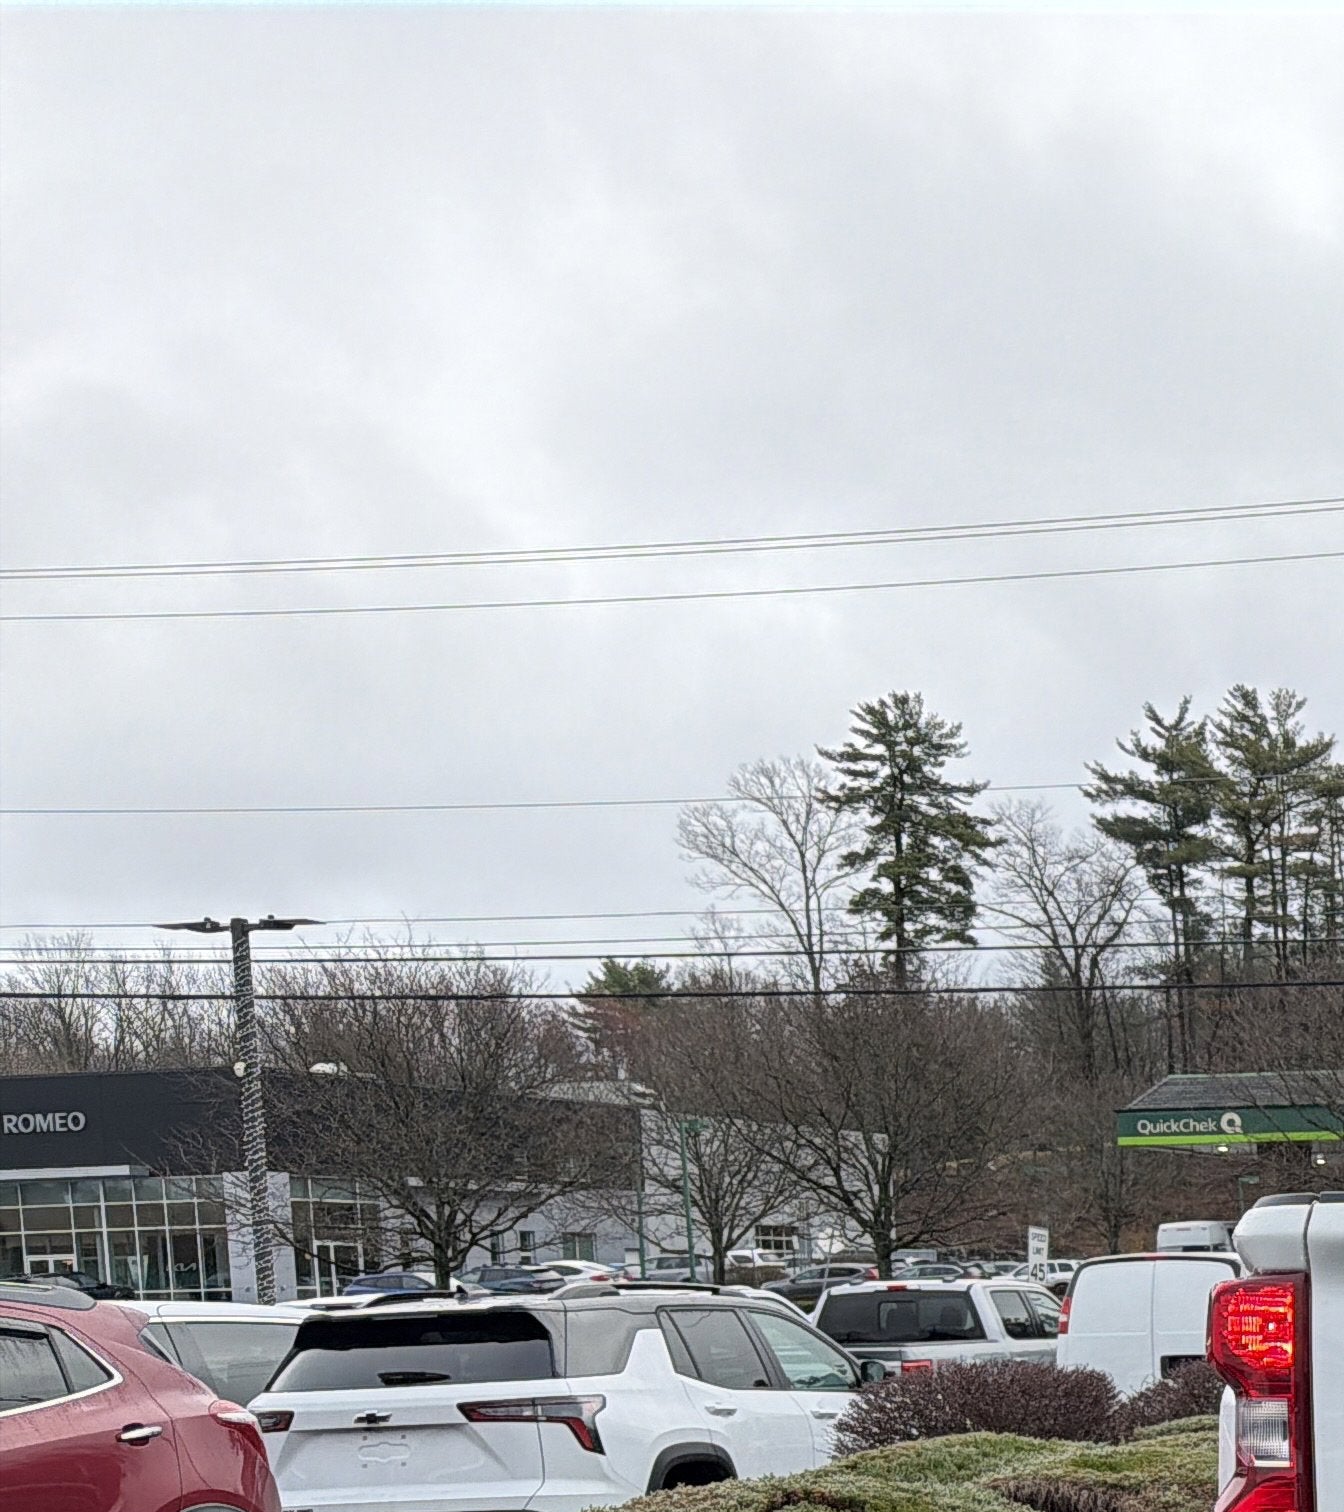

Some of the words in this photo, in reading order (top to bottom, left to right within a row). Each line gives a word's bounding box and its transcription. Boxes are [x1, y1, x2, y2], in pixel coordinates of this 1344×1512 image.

[3, 1112, 86, 1134] ROMEO
[1137, 1118, 1218, 1135] QuickChek
[1031, 1232, 1047, 1243] SPEED
[1032, 1246, 1045, 1255] LIMIT
[1030, 1263, 1046, 1281] 45
